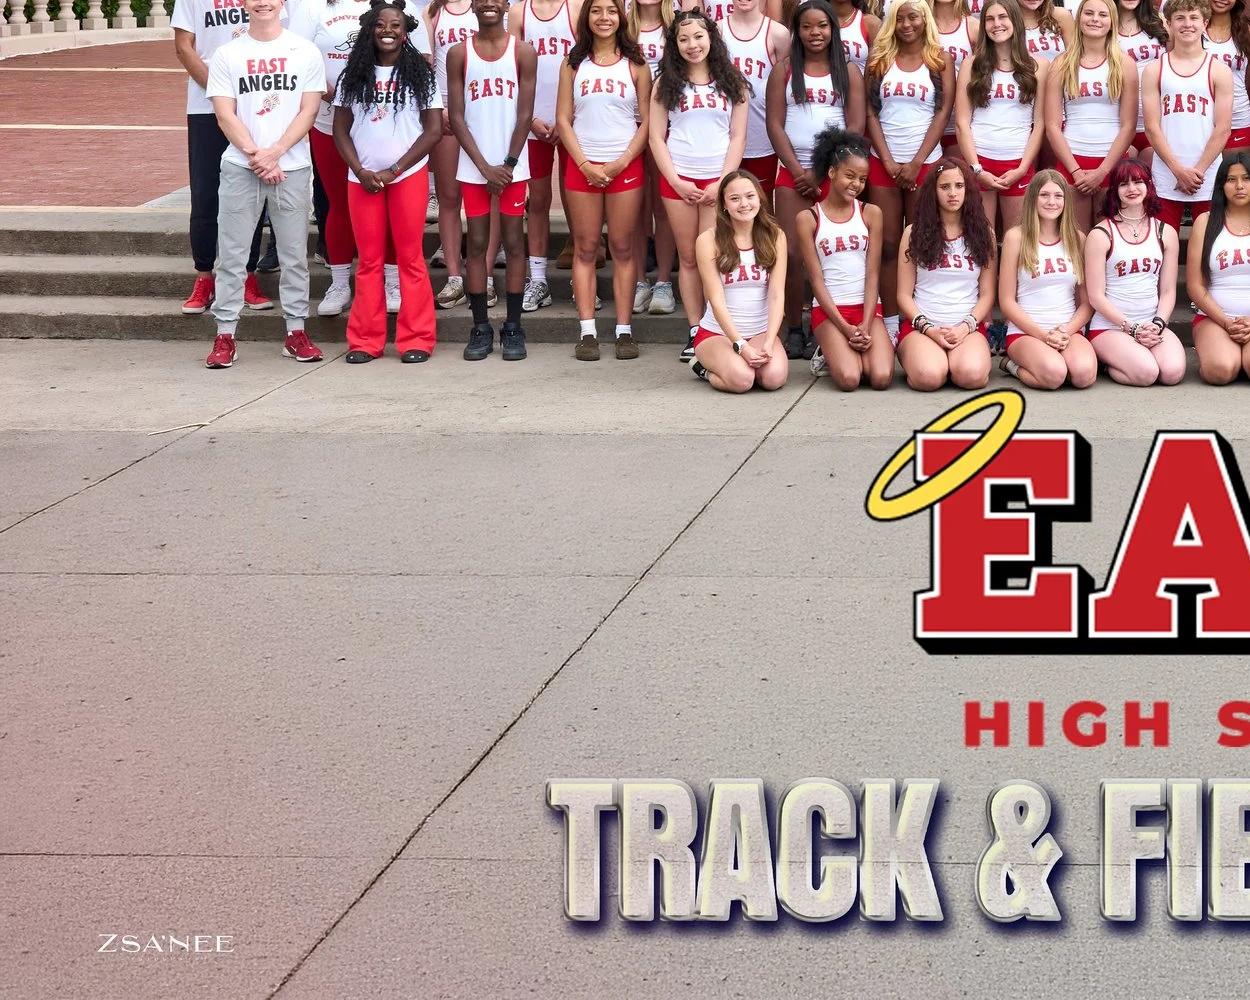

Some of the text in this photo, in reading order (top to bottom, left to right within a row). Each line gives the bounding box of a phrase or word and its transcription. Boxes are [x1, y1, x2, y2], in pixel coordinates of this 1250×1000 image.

[204, 9, 250, 28] ANGE
[326, 15, 358, 27] DENVE
[532, 37, 571, 57] AST
[1027, 36, 1061, 53] AST
[1127, 44, 1160, 61] AST
[246, 57, 288, 75] EAST
[238, 74, 298, 95] ANGELS
[469, 78, 515, 101] EAST
[580, 79, 627, 98] EAST
[882, 82, 928, 101] EAST
[680, 94, 728, 112] EAST
[1163, 94, 1208, 116] EAST
[1114, 258, 1161, 277] EAST
